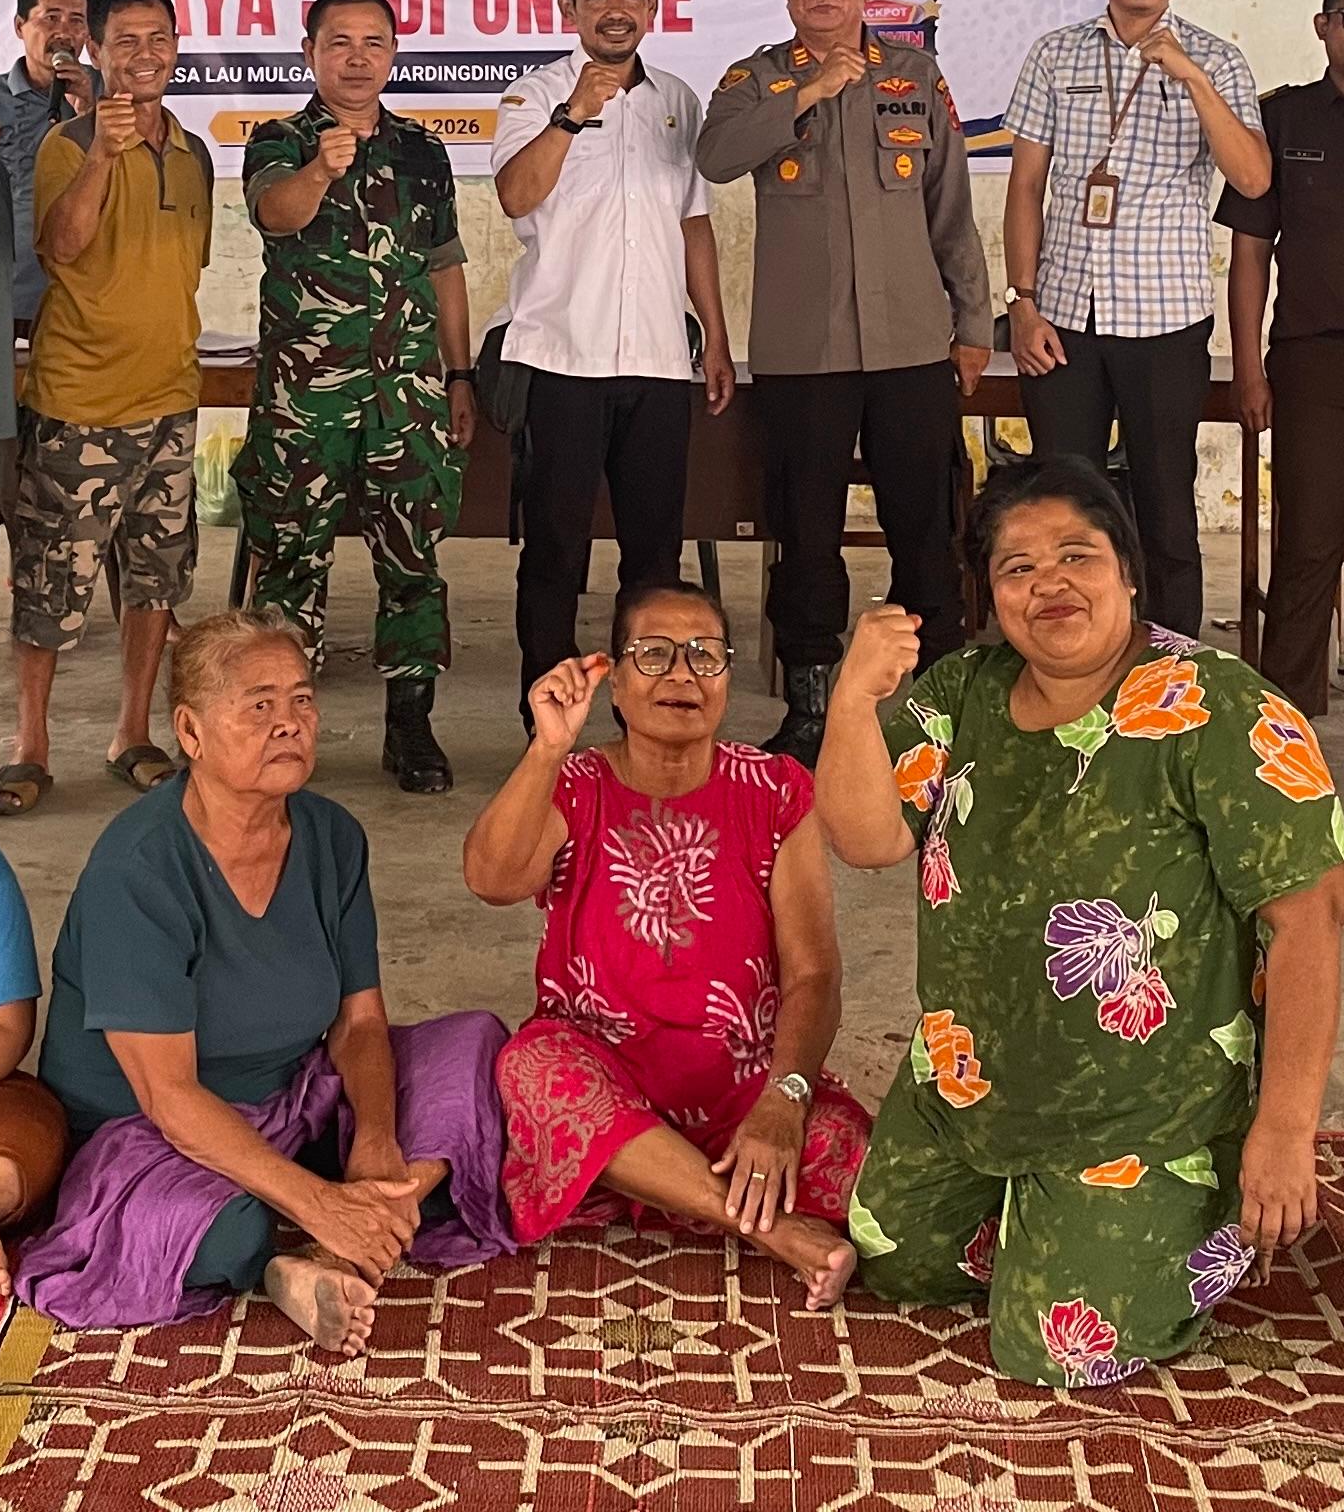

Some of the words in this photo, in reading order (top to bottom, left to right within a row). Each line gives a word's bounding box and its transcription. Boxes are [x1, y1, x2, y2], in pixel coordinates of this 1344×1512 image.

[168, 66, 201, 83] SA
[205, 66, 243, 83] LAU
[247, 65, 316, 83] MULGA
[876, 101, 927, 116] POLRI
[432, 118, 480, 135] 2026
